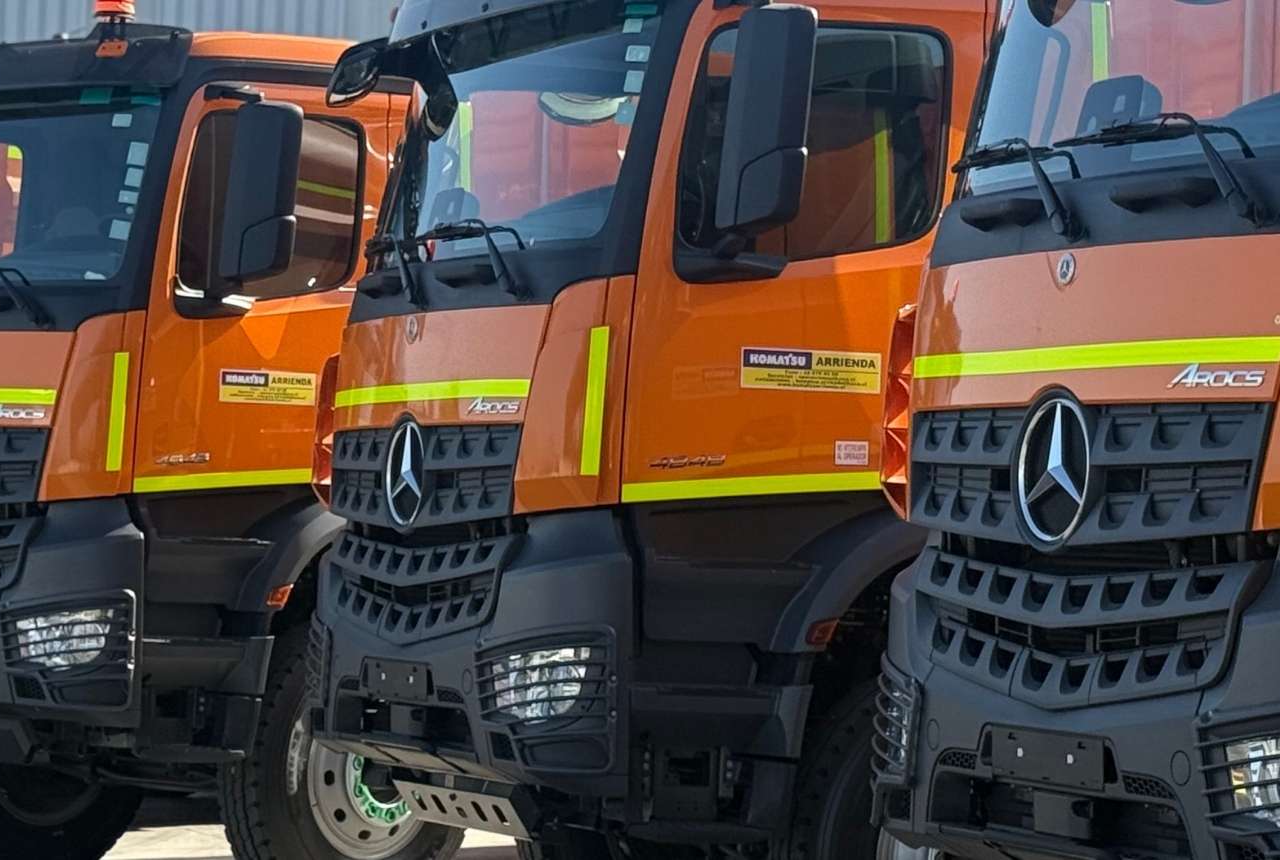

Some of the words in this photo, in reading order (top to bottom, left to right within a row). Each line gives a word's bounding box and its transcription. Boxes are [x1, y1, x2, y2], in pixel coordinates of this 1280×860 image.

[749, 353, 806, 366] KOMATSU
[816, 356, 876, 369] ARRIENDA
[225, 374, 265, 385] KOMATSU
[271, 376, 312, 386] ARRIENDA
[1166, 363, 1266, 389] AROCS
